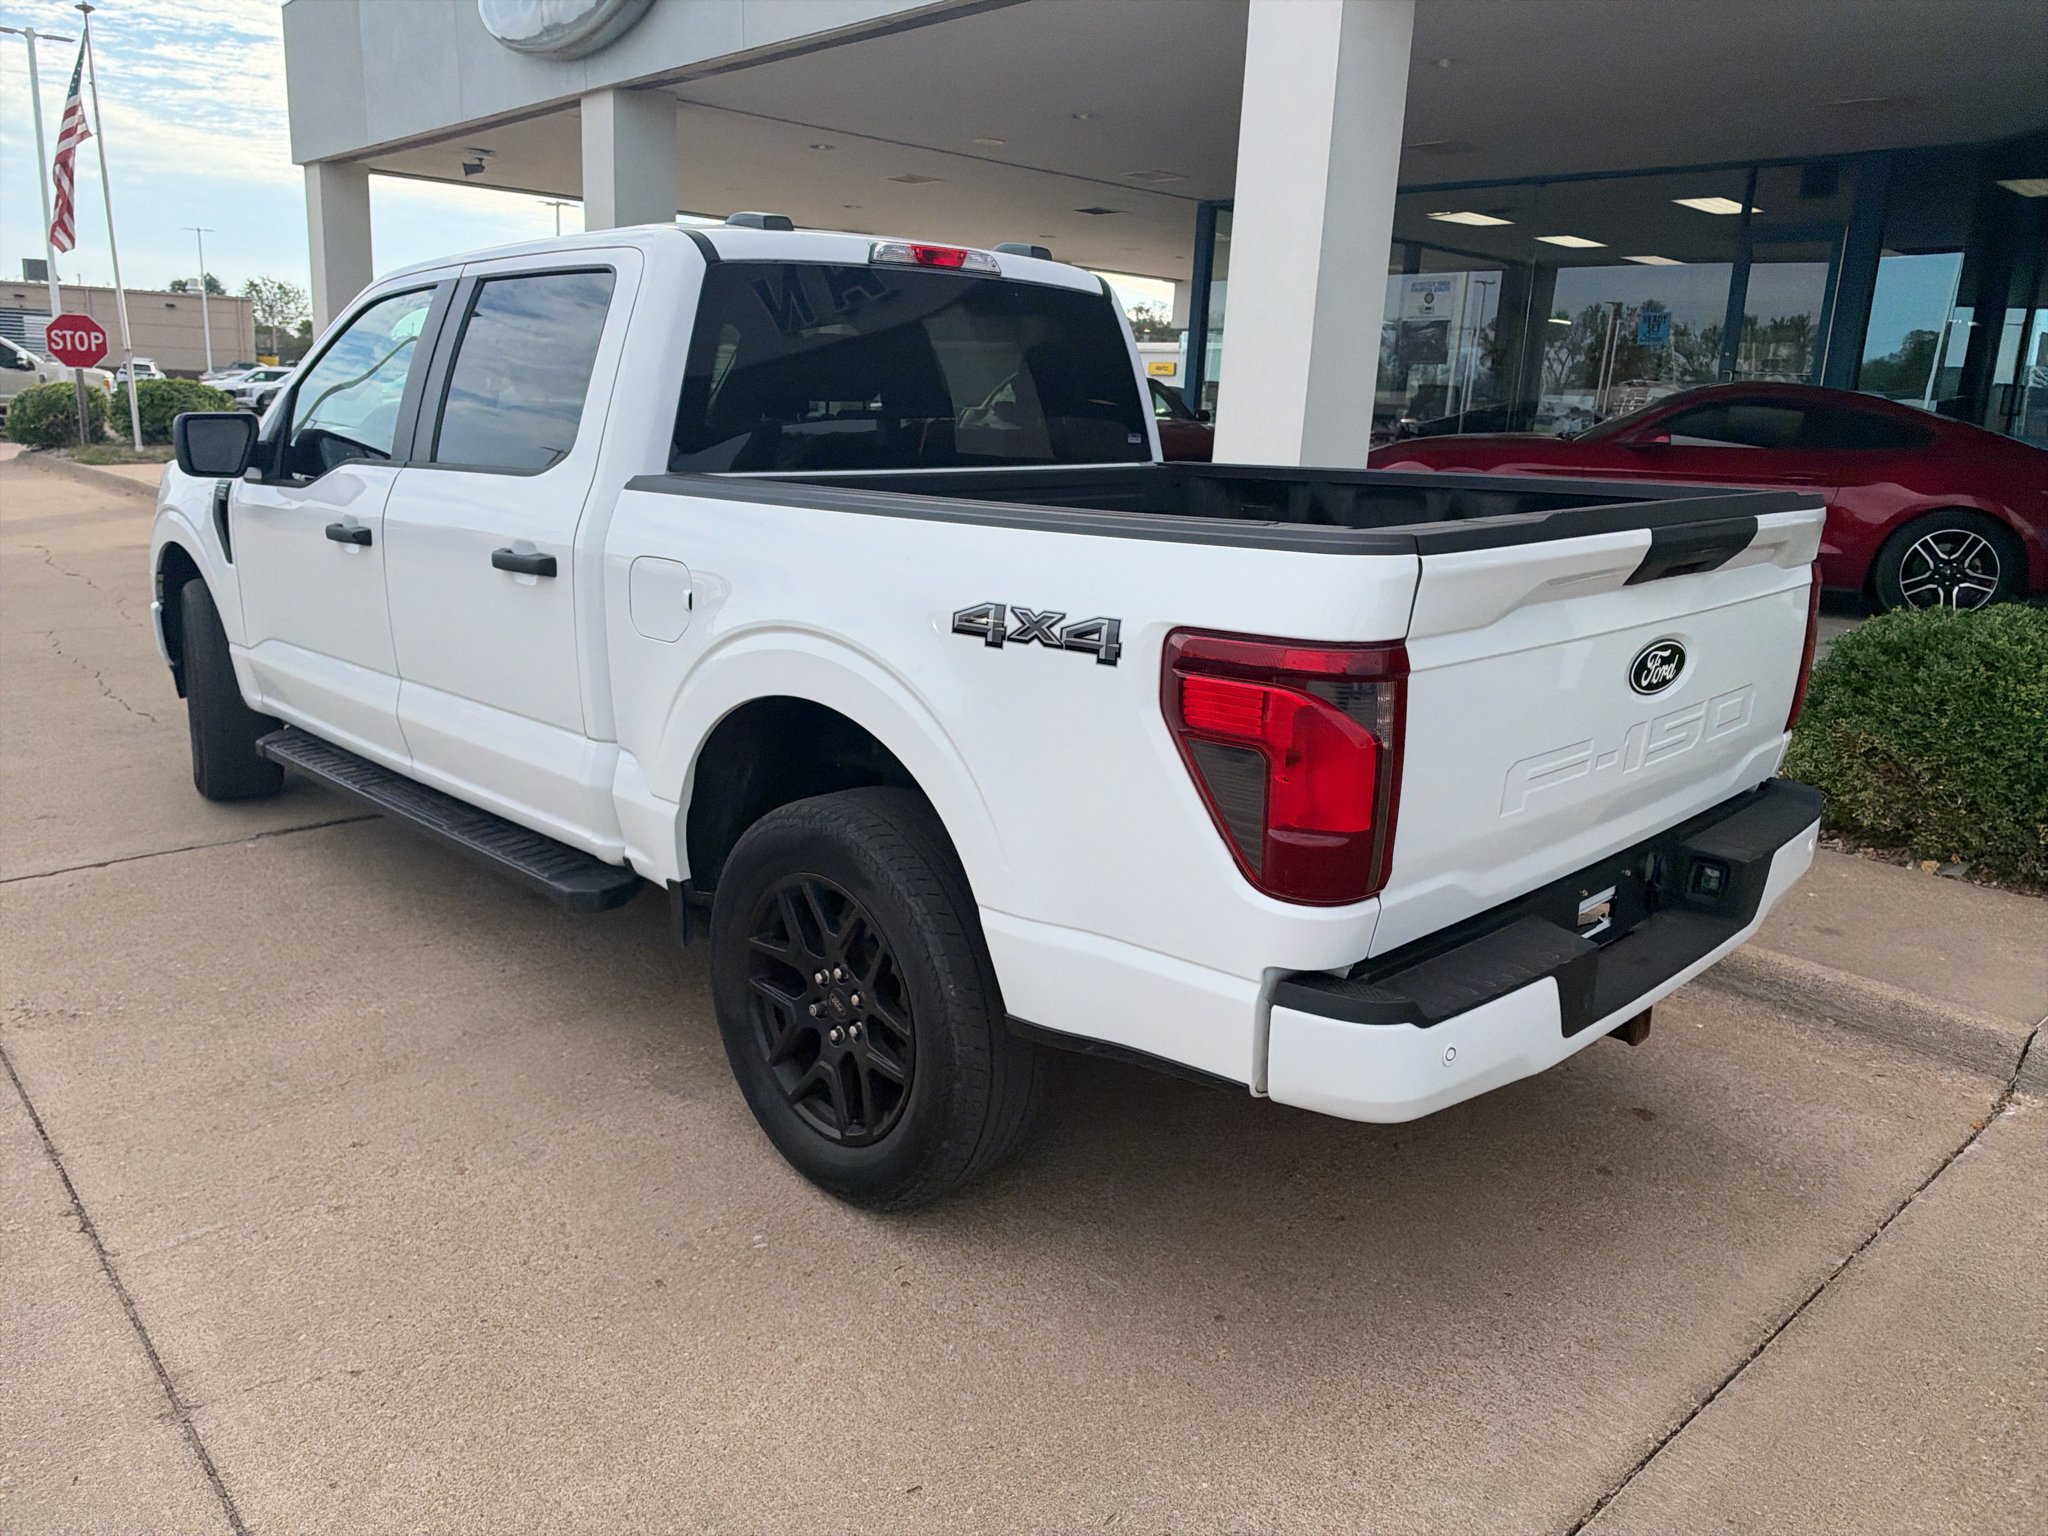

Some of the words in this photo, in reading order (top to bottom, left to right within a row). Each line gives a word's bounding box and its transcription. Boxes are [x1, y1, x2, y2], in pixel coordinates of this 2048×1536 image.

[50, 329, 104, 352] STOP
[1640, 649, 1680, 687] Ford
[1499, 683, 1757, 819] F-150
